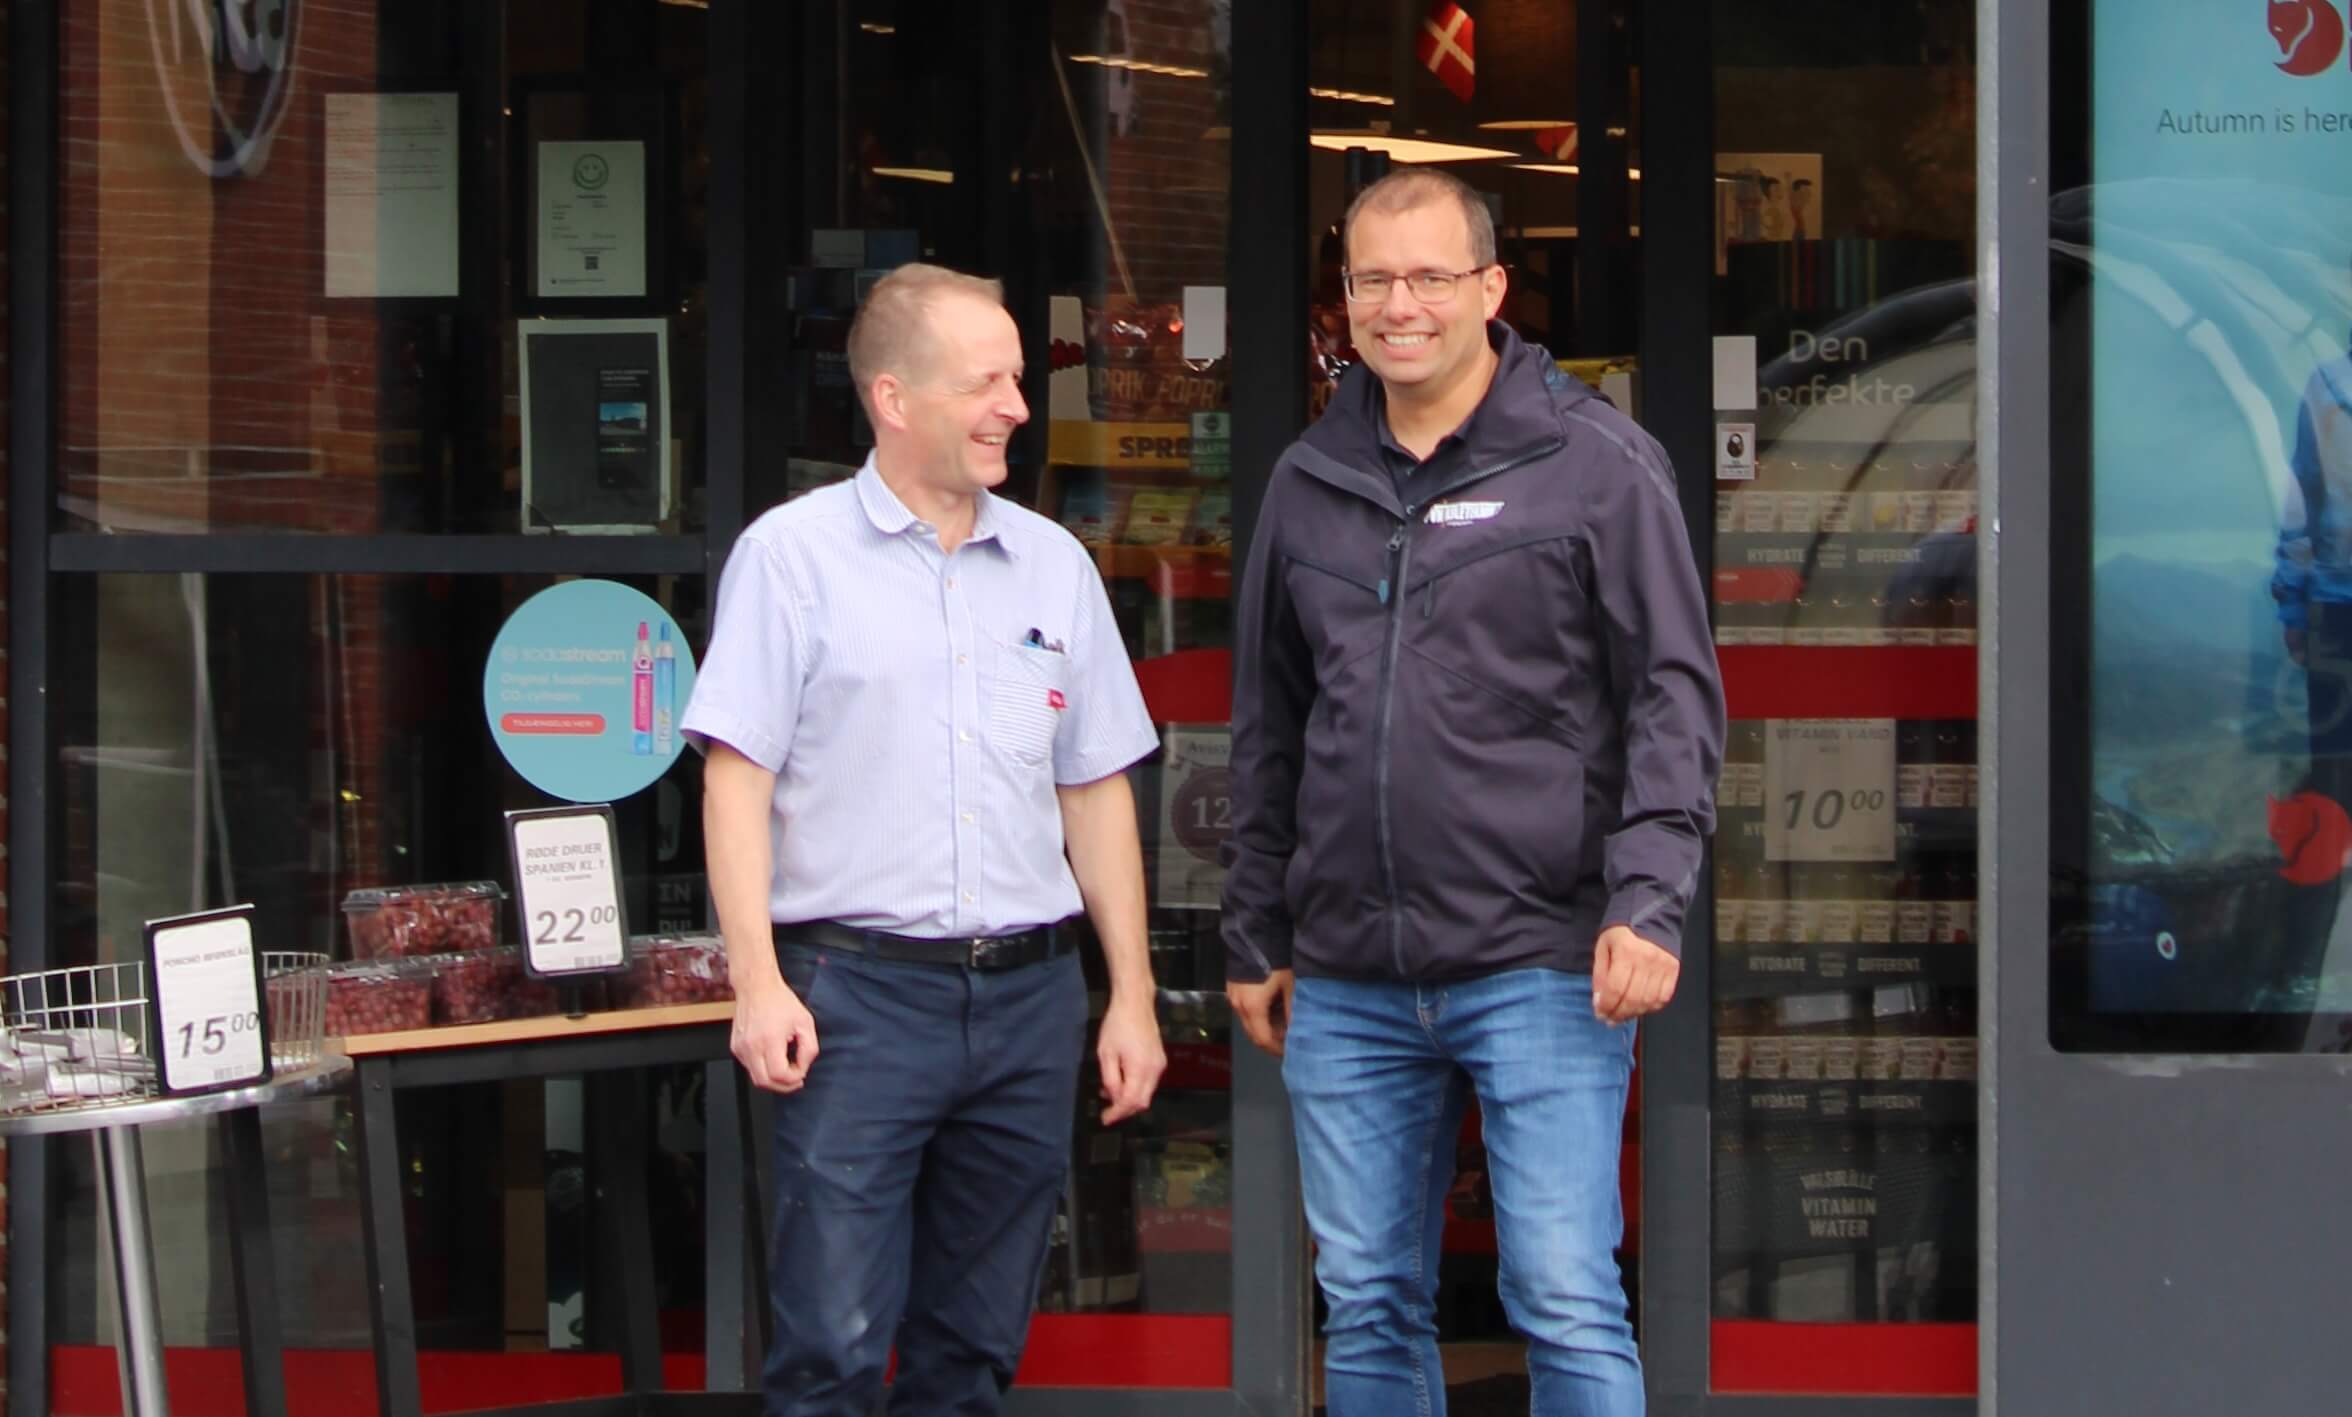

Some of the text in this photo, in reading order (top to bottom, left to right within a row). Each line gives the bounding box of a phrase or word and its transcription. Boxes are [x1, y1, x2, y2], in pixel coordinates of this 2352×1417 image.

[2157, 108, 2265, 134] Autumn
[2275, 107, 2295, 133] is
[1788, 330, 1868, 363] Den
[526, 846, 560, 859] RØDE
[1802, 1198, 1877, 1216] VITAMIN
[1809, 1219, 1869, 1238] WATER
